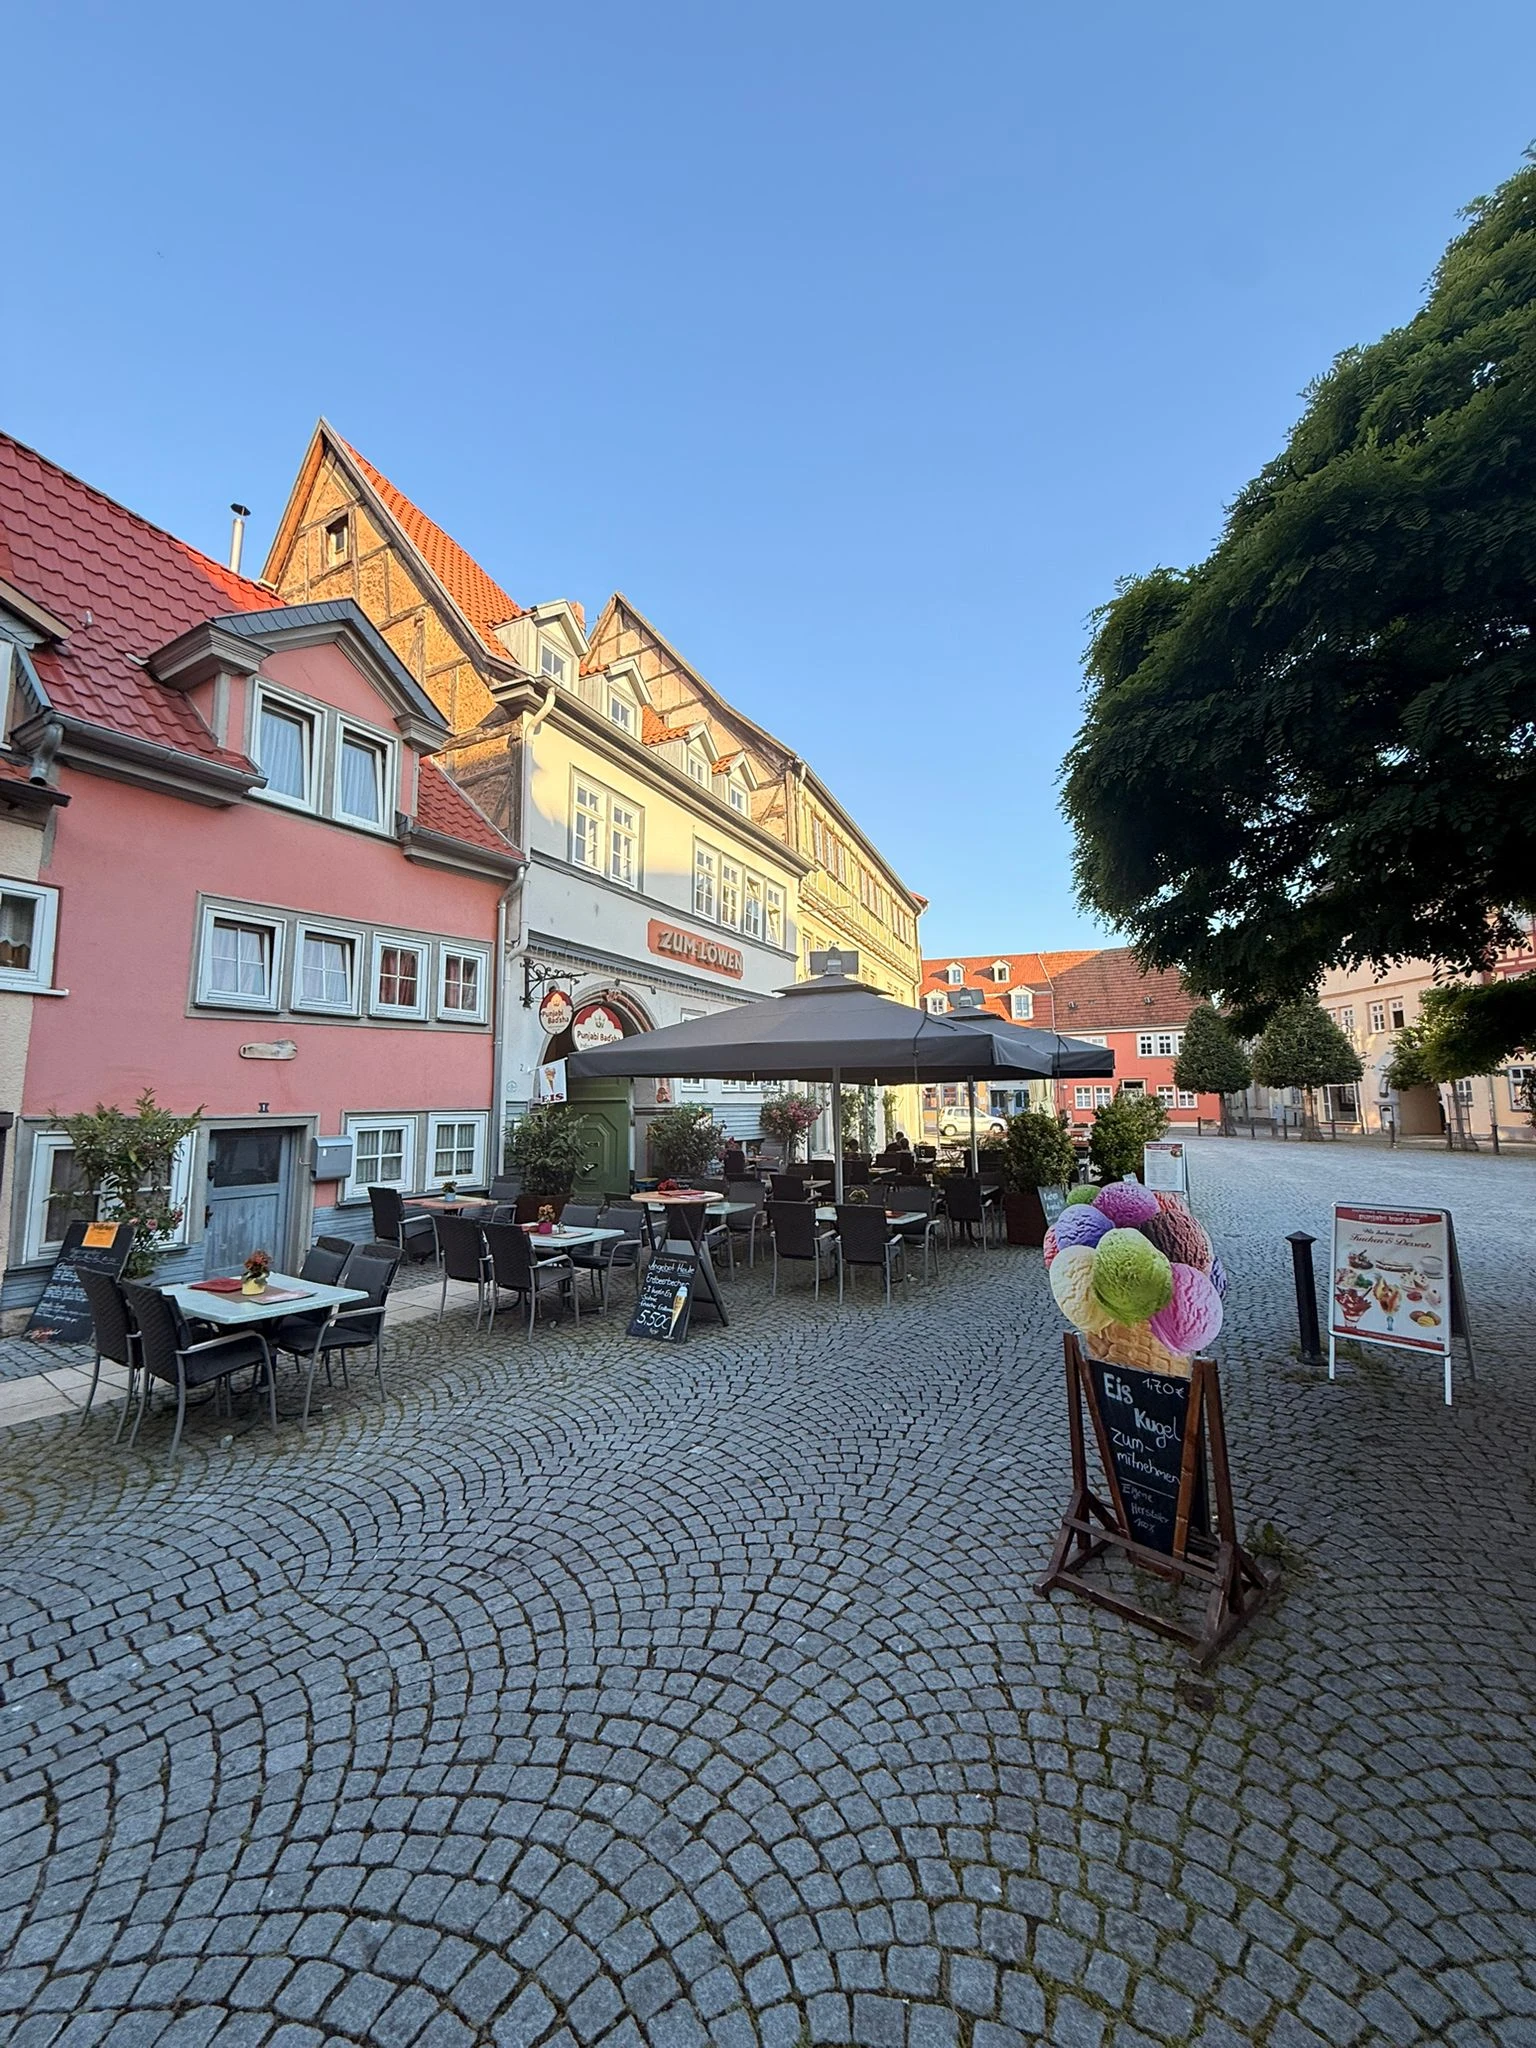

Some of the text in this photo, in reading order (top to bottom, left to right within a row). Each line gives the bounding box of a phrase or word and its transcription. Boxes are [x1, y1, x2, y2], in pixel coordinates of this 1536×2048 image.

[658, 931, 743, 972] ZUM LÖWEN
[542, 1009, 564, 1018] Punjabi
[577, 1031, 599, 1041] Punjabi
[541, 1092, 564, 1103] EIS
[1395, 1238, 1432, 1249] Desserts
[1103, 1372, 1185, 1405] Eis 1,70€
[1134, 1407, 1181, 1449] Kugel
[1116, 1451, 1180, 1485] mitnehmen
